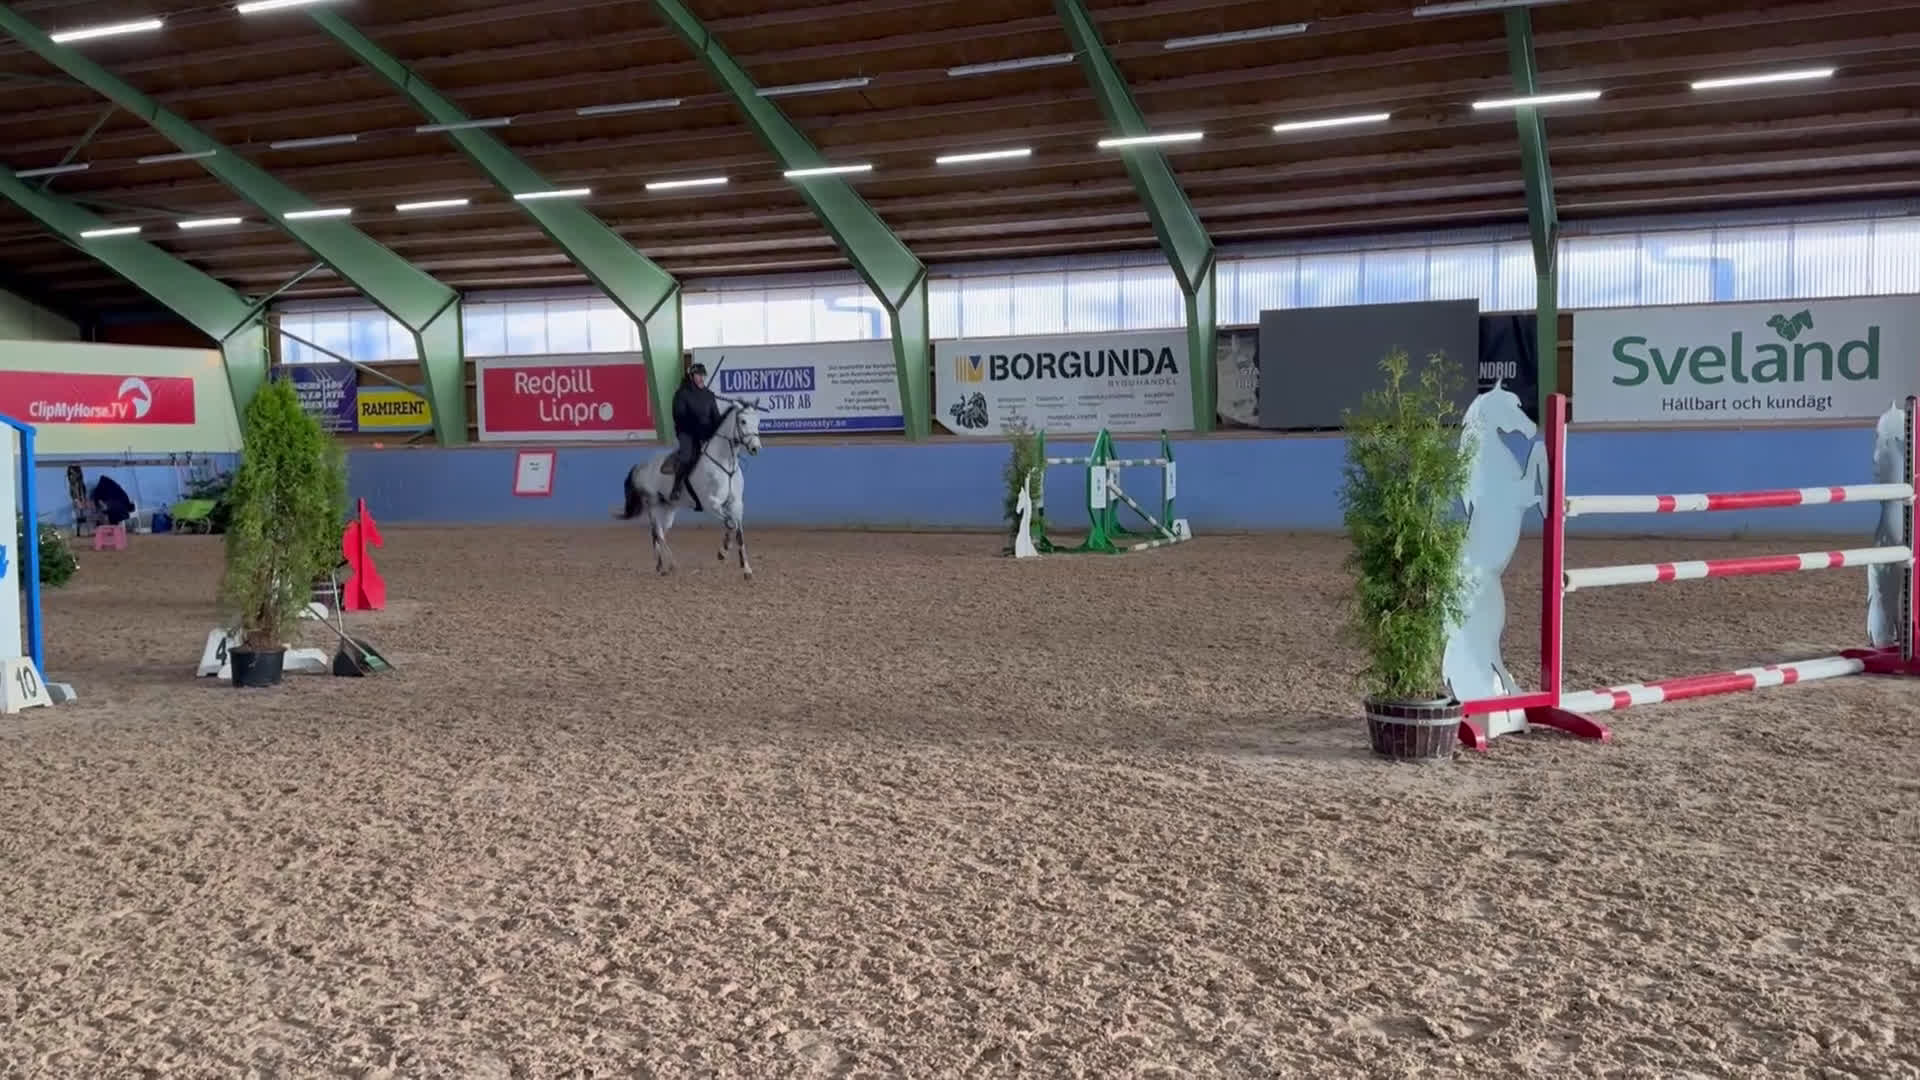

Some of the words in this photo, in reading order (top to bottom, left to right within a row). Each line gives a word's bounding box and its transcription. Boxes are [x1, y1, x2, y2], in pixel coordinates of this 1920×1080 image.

[988, 347, 1178, 382] BORGUNDA
[1612, 326, 1880, 386] Sveland
[724, 368, 811, 392] LORENTZONS
[1479, 360, 1517, 379] NDBIO
[515, 368, 594, 399] Redpill
[29, 401, 128, 421] ClipMyHorse.TV
[362, 400, 424, 417] RAMIRENT
[539, 398, 613, 427] Linpro
[768, 395, 795, 411] STYR
[797, 394, 812, 410] AB
[1661, 397, 1727, 412] Hållbart
[1732, 396, 1761, 411] och
[1766, 394, 1832, 412] kundägt
[215, 637, 227, 666] 4
[16, 666, 37, 700] 10
